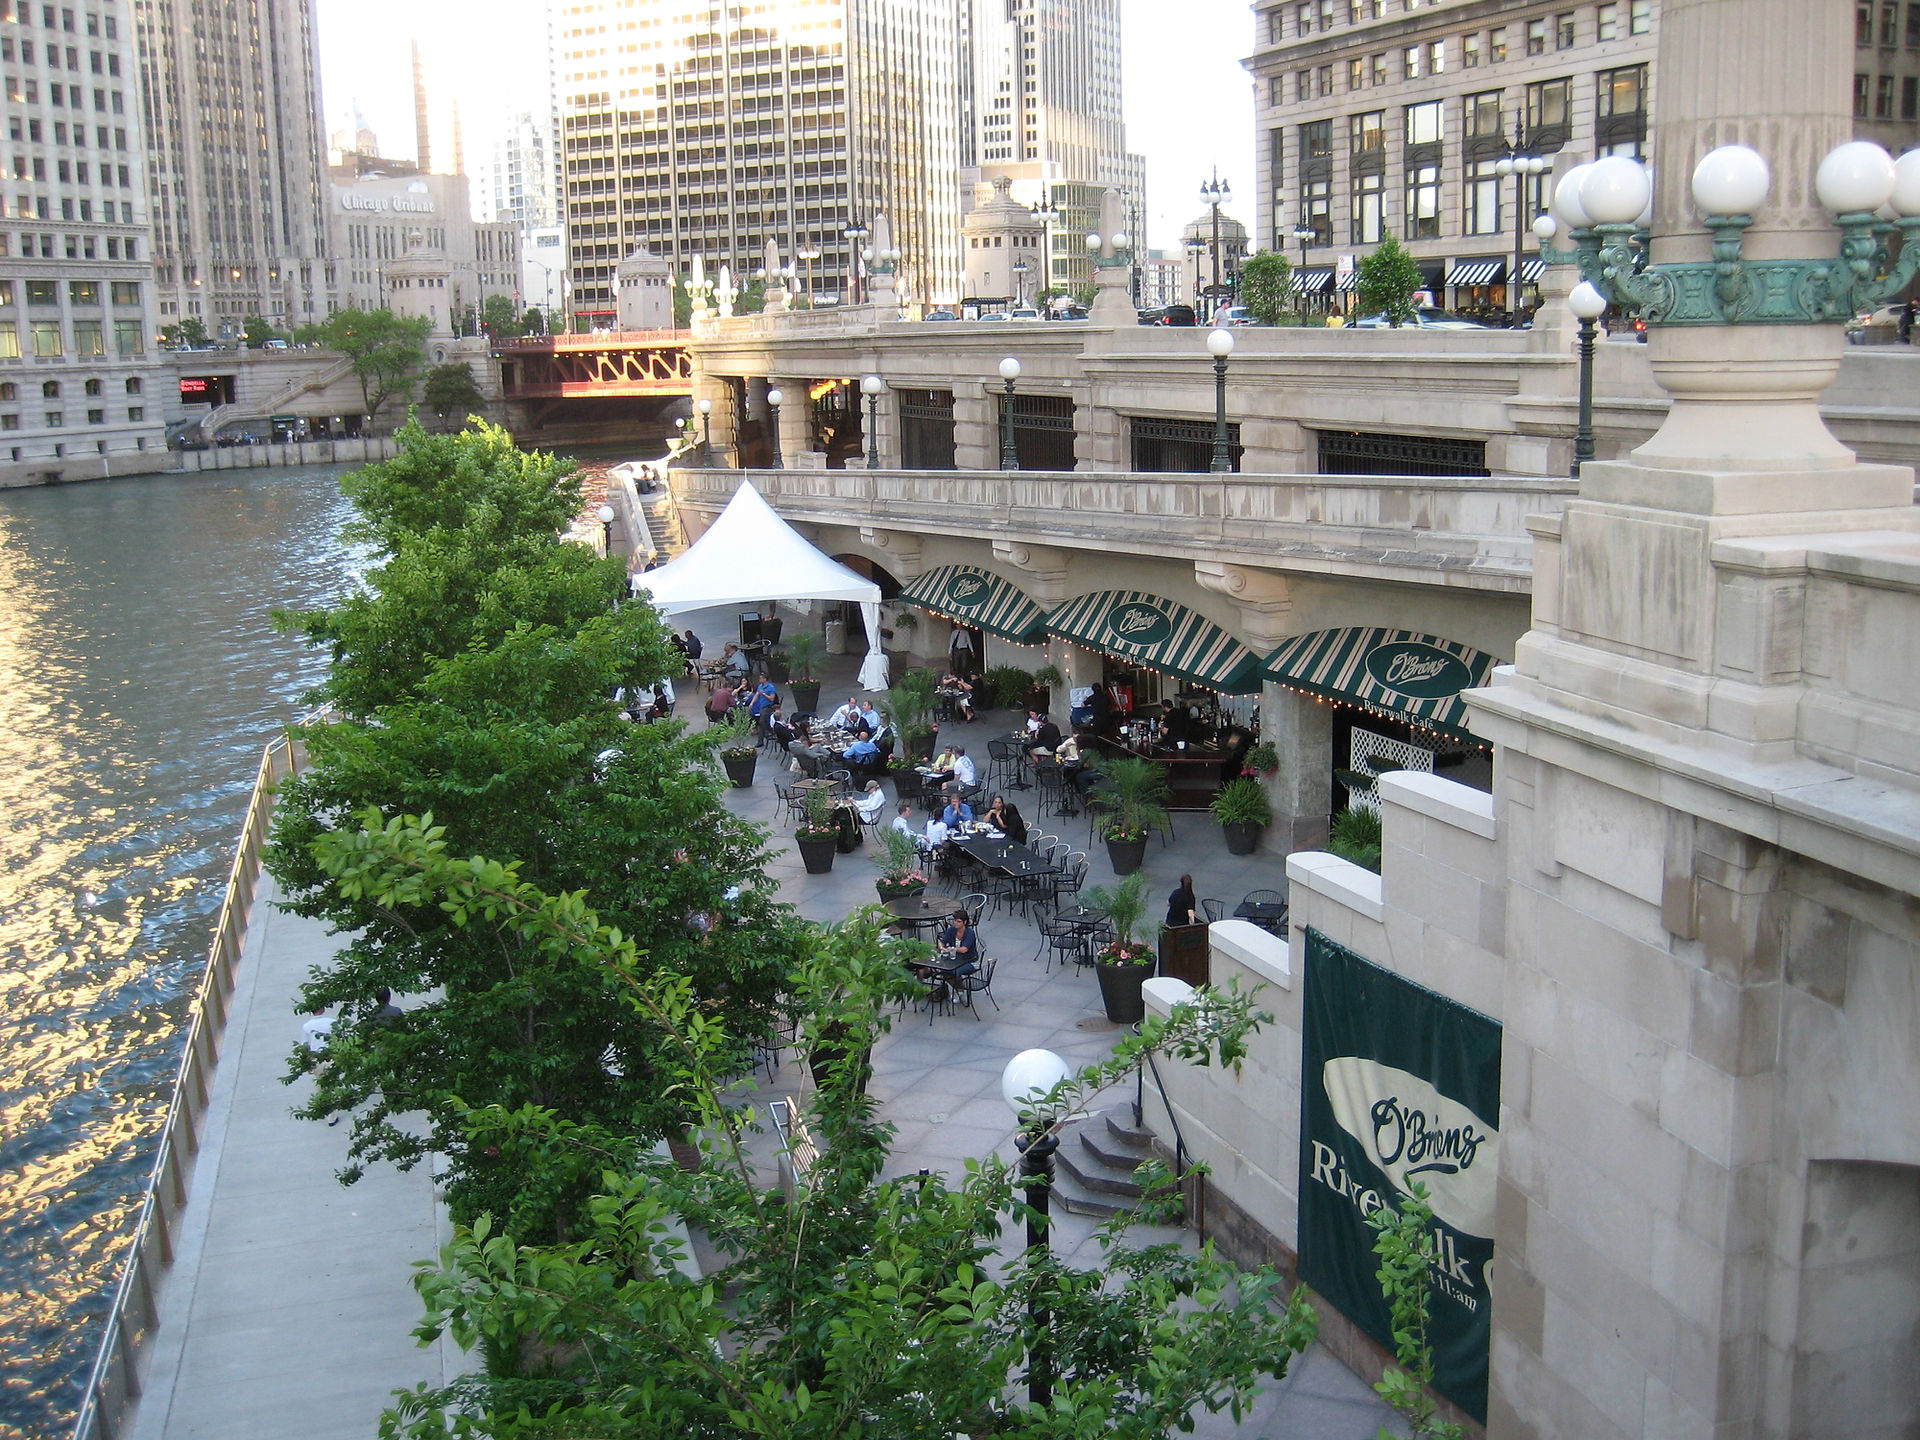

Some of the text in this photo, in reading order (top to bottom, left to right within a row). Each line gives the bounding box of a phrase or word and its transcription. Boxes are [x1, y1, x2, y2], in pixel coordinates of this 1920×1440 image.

[342, 192, 435, 213] Chicago Tribune
[1363, 699, 1434, 731] Riverwalk Café
